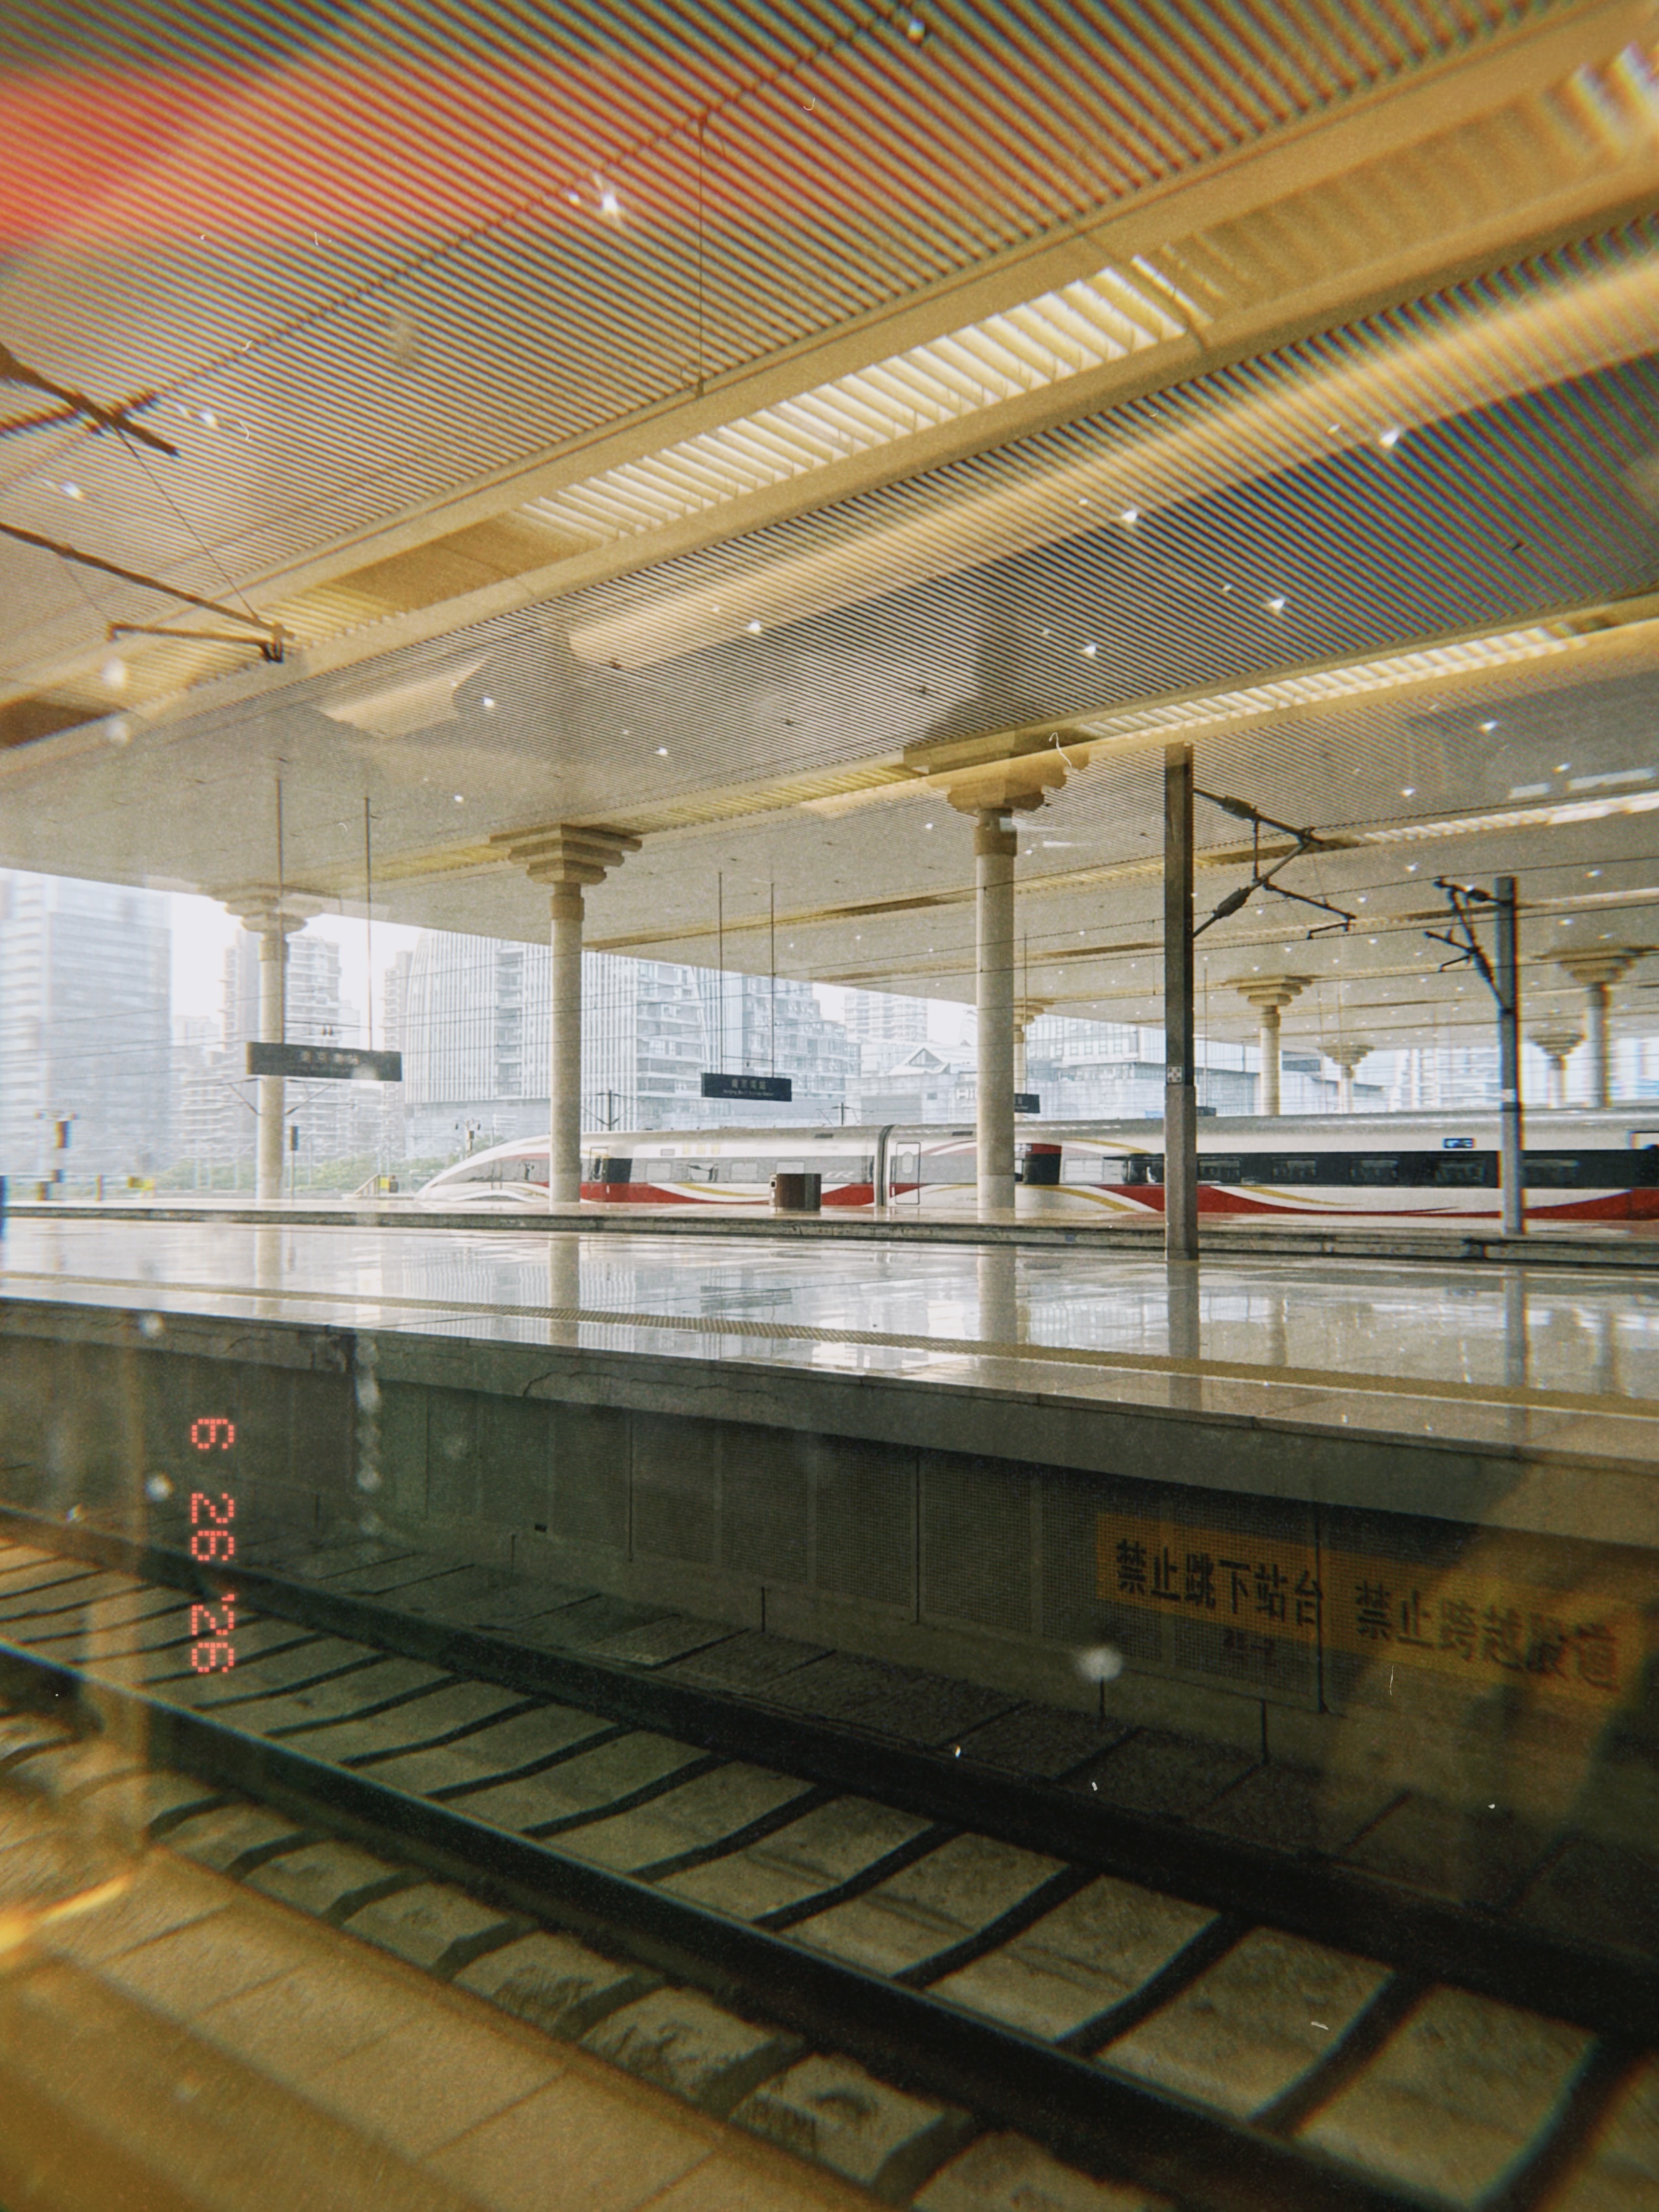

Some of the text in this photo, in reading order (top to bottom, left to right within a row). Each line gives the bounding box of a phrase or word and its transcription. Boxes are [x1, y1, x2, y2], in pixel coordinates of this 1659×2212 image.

[1116, 1539, 1323, 1627] 禁止跳下站台
